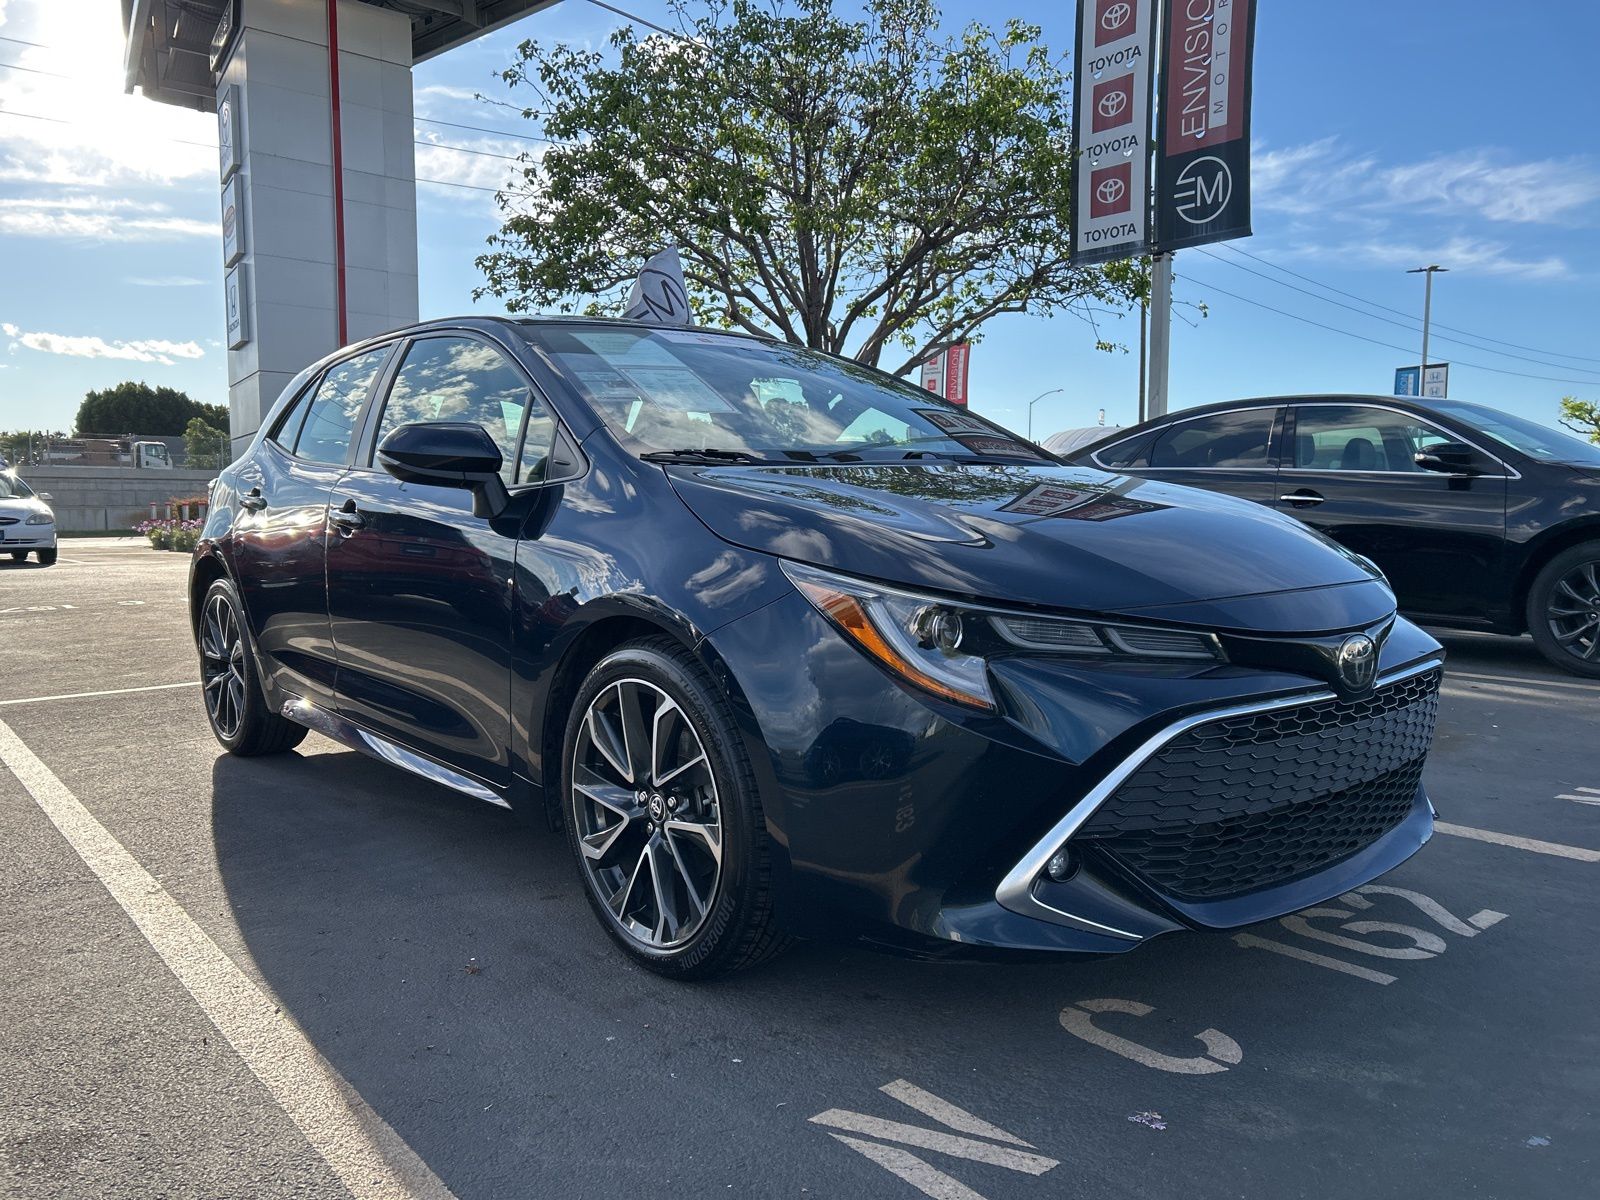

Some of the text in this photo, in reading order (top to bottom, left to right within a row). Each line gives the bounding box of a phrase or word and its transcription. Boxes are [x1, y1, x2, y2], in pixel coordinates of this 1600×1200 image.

[1088, 45, 1142, 74] TOYOTA
[1086, 135, 1138, 159] TOYOTA
[1084, 223, 1137, 243] TOYOTA
[678, 892, 737, 971] BRIDGESTONE
[1059, 999, 1243, 1075] C
[1231, 884, 1510, 986] 152
